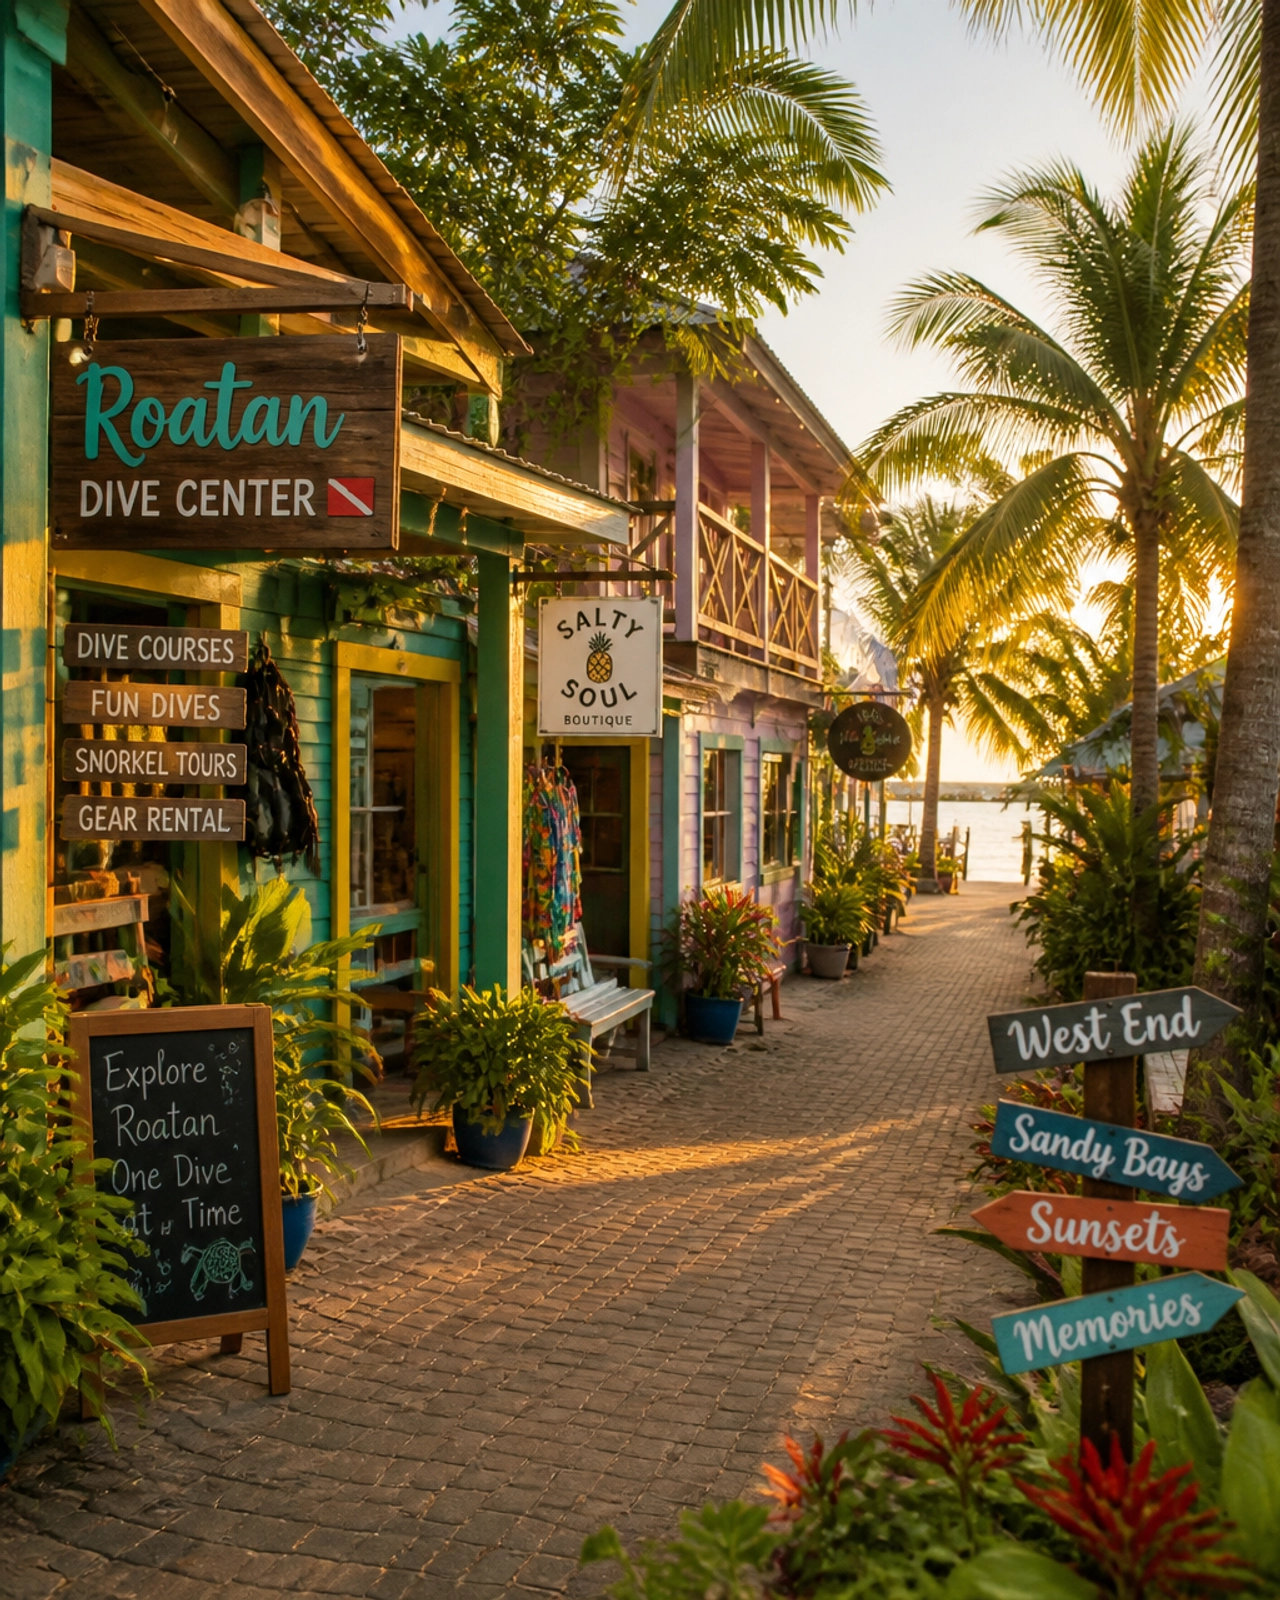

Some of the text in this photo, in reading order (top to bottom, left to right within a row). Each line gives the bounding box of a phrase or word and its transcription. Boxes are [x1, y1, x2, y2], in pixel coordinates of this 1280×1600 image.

[76, 362, 345, 467] Roatan
[80, 478, 316, 518] DIVE CENTER
[557, 607, 644, 640] SALTY
[77, 632, 234, 664] DIVE COURSES
[91, 689, 221, 721] FUN DIVES
[561, 678, 638, 708] SOUL
[563, 714, 633, 728] BOUTIQUE
[75, 747, 237, 778] SNORKEL TOURS
[78, 804, 231, 833] GEAR RENTAL
[1007, 994, 1202, 1061] West End
[103, 1049, 207, 1100] Explore
[110, 1101, 220, 1147] Roatan
[111, 1153, 232, 1195] One Dive
[1008, 1112, 1211, 1196] Sandy Bays
[181, 1197, 243, 1229] Time
[1026, 1200, 1186, 1259] Sunsets
[1013, 1293, 1203, 1362] Memories
